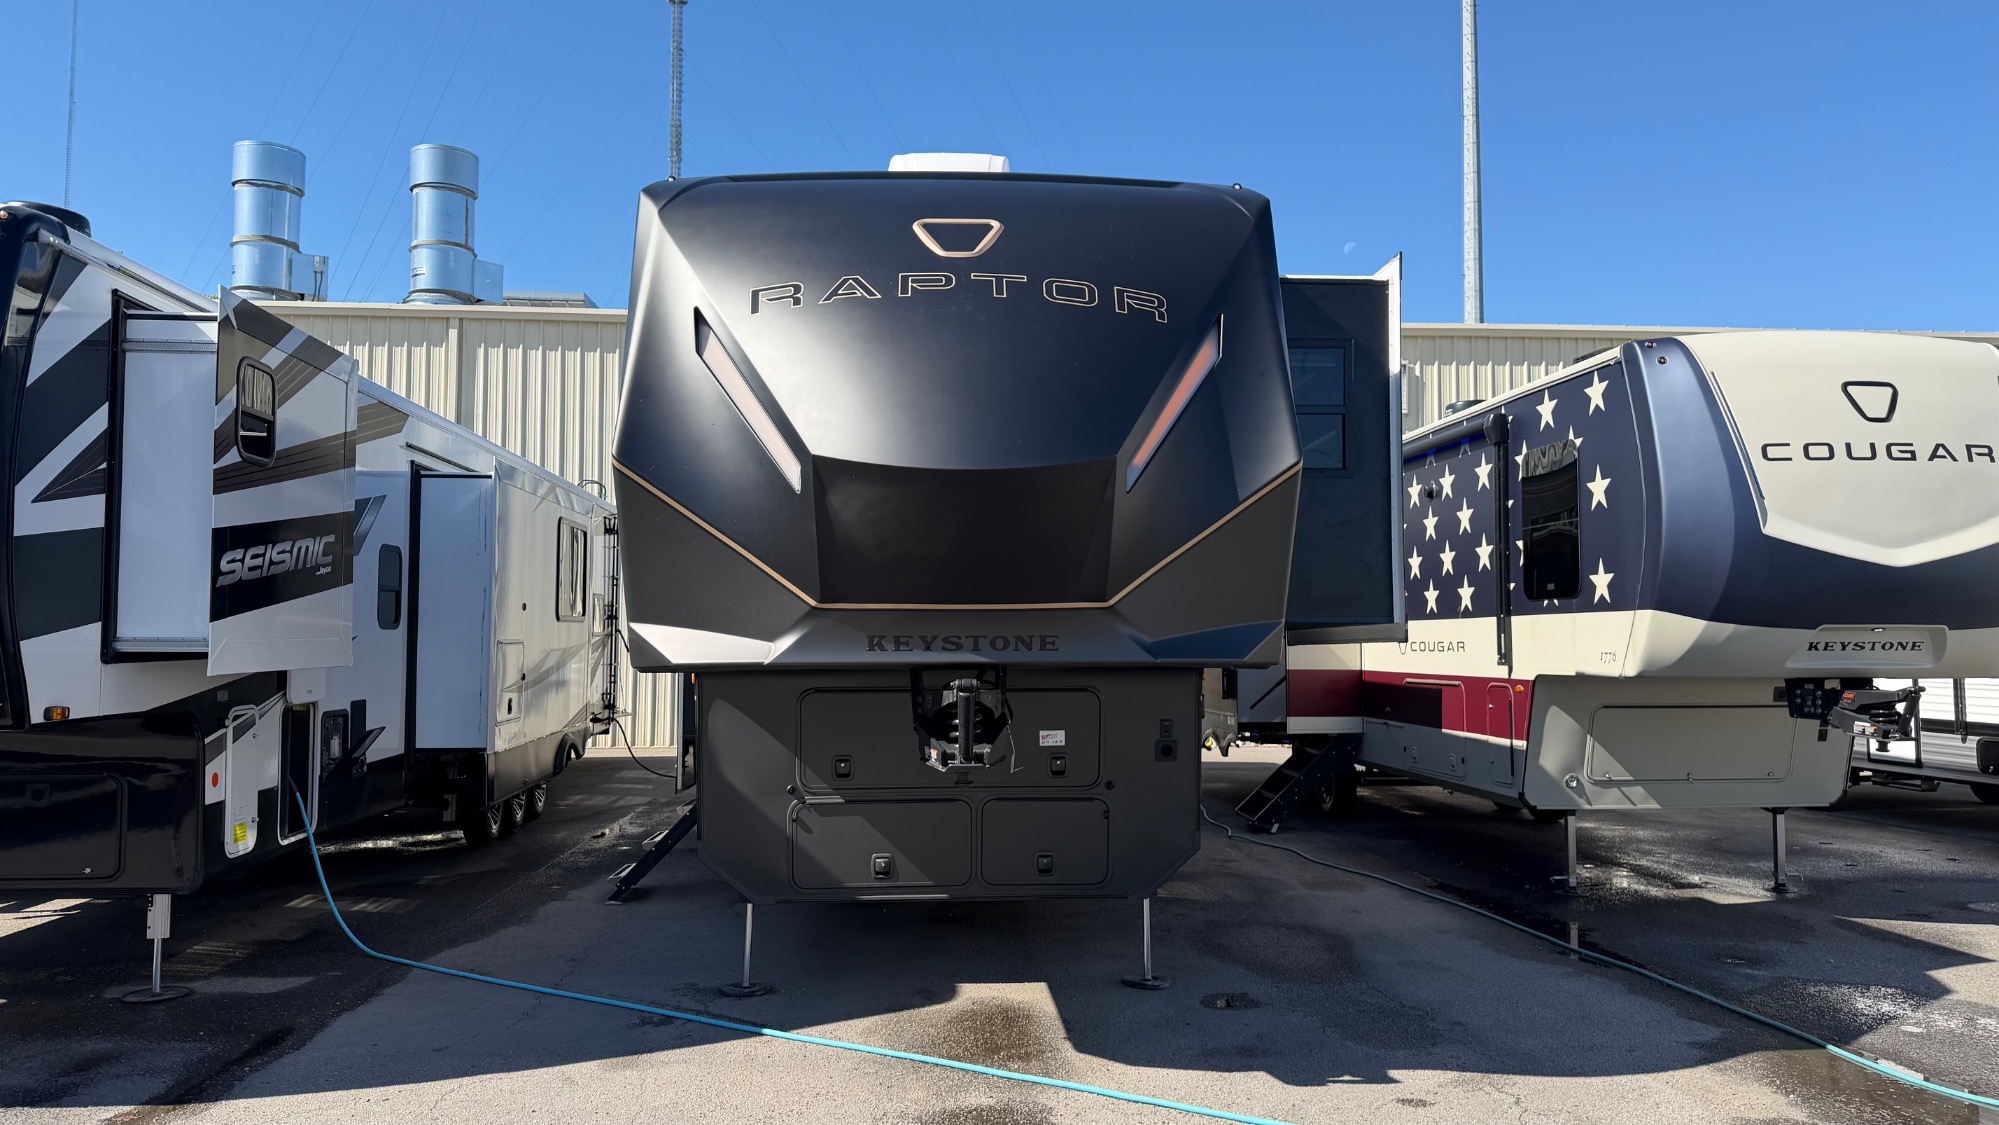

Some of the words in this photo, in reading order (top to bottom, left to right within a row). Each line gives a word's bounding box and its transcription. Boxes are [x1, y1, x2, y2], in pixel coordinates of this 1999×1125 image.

[749, 272, 1168, 323] RAPTOR
[1760, 442, 1996, 463] COUGAR
[216, 534, 336, 587] SEISMIC
[866, 634, 1060, 652] KEYSTONE
[1410, 641, 1466, 652] COUGAR
[1806, 641, 1925, 651] KEYSTONE
[1600, 650, 1617, 664] 1776
